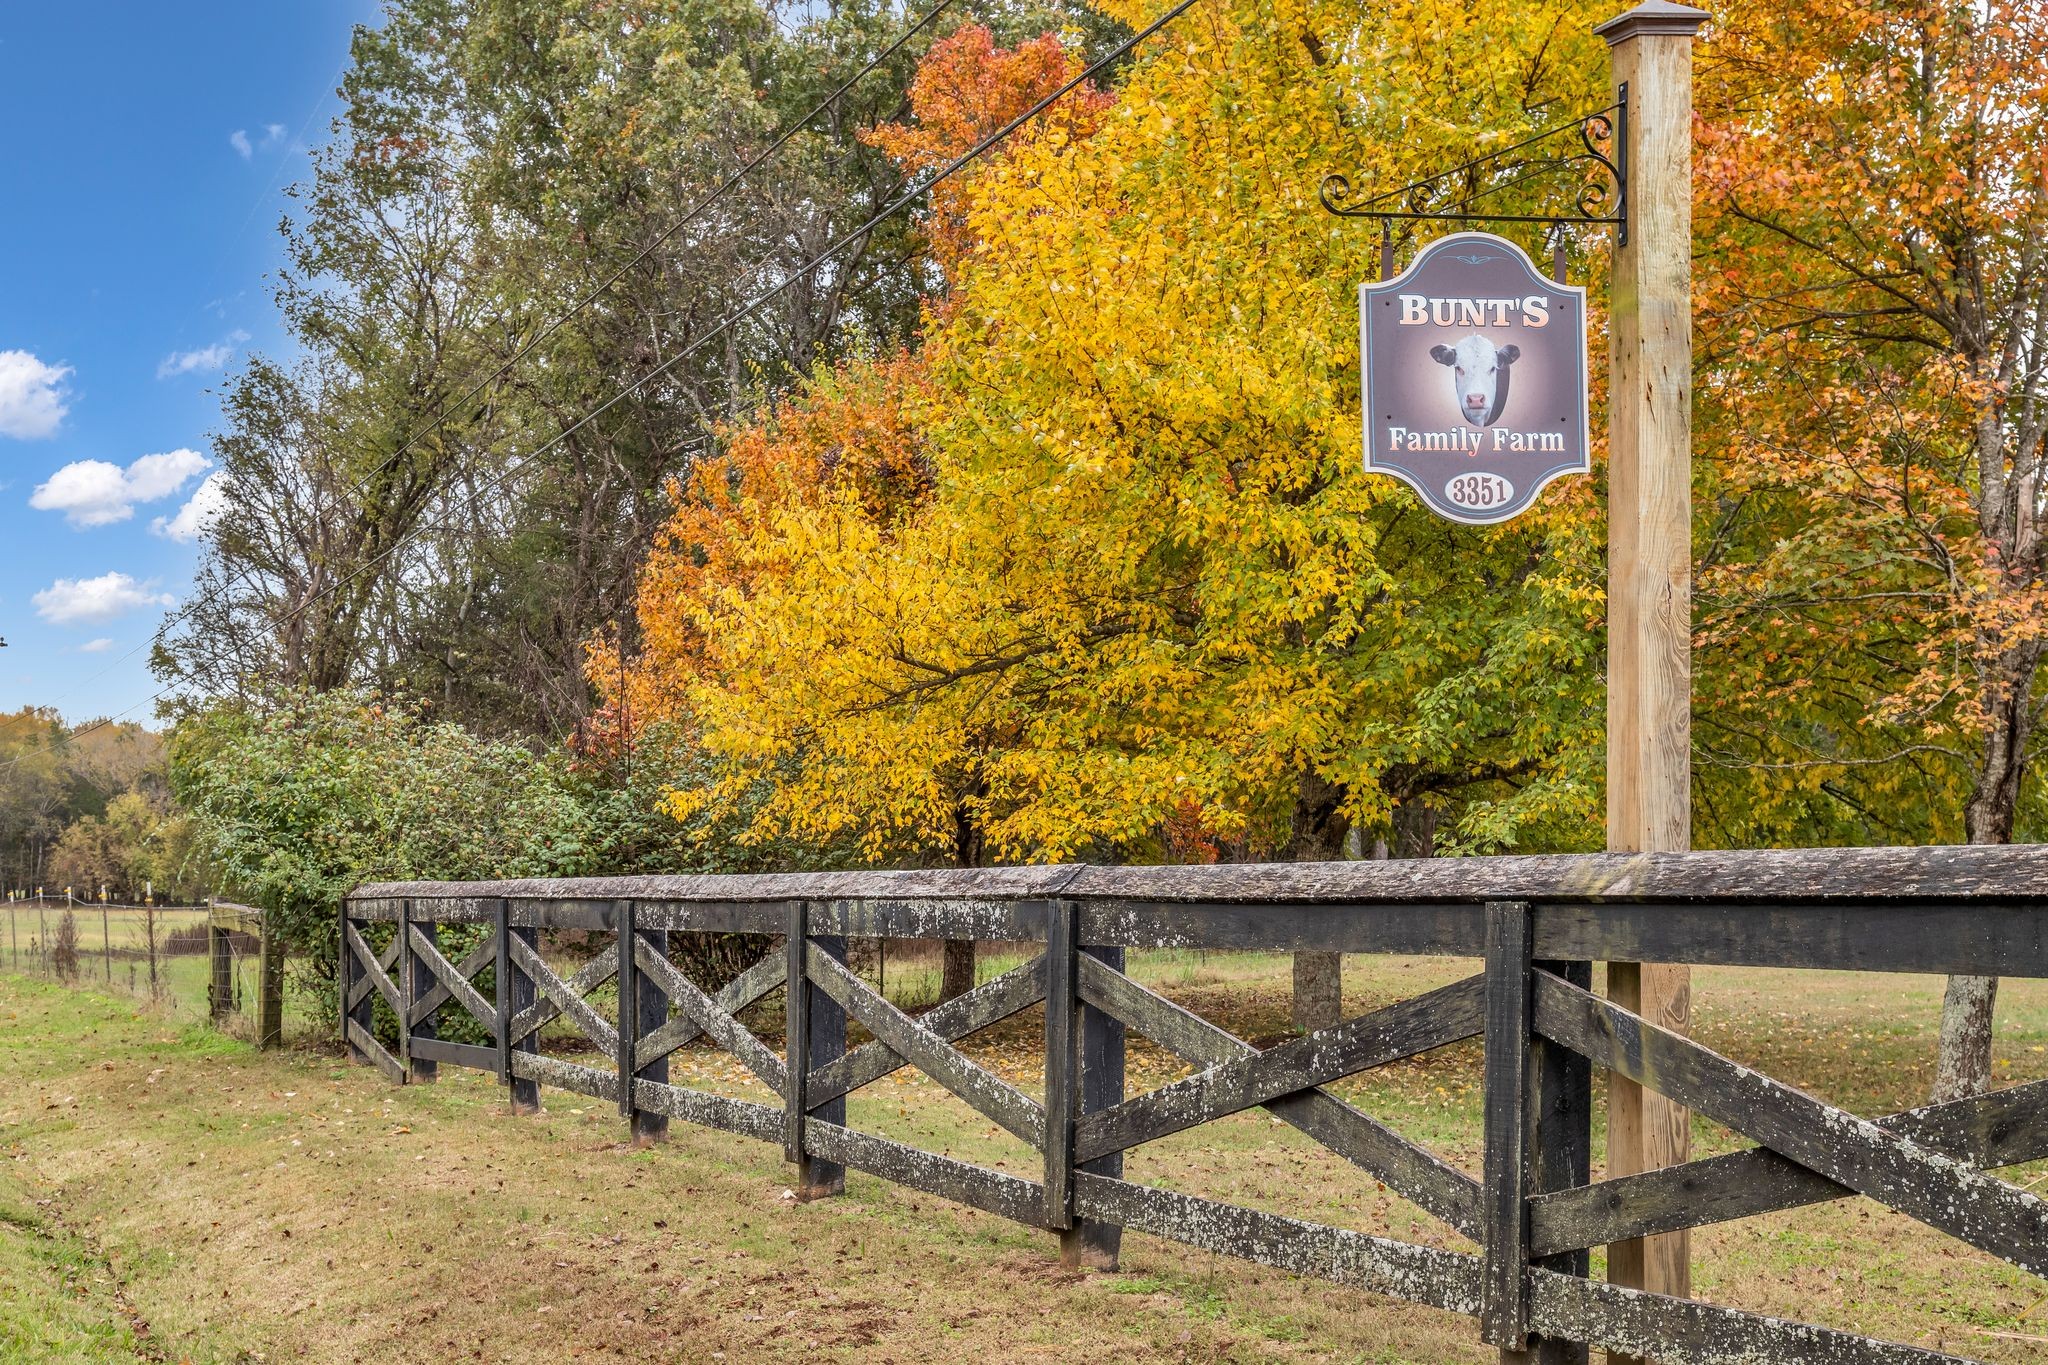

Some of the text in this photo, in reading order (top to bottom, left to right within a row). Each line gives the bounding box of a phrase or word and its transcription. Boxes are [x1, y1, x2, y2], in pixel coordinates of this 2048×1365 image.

[1398, 294, 1550, 328] BUNT'S
[1389, 426, 1566, 456] Family Farm
[1453, 476, 1507, 506] 3351
